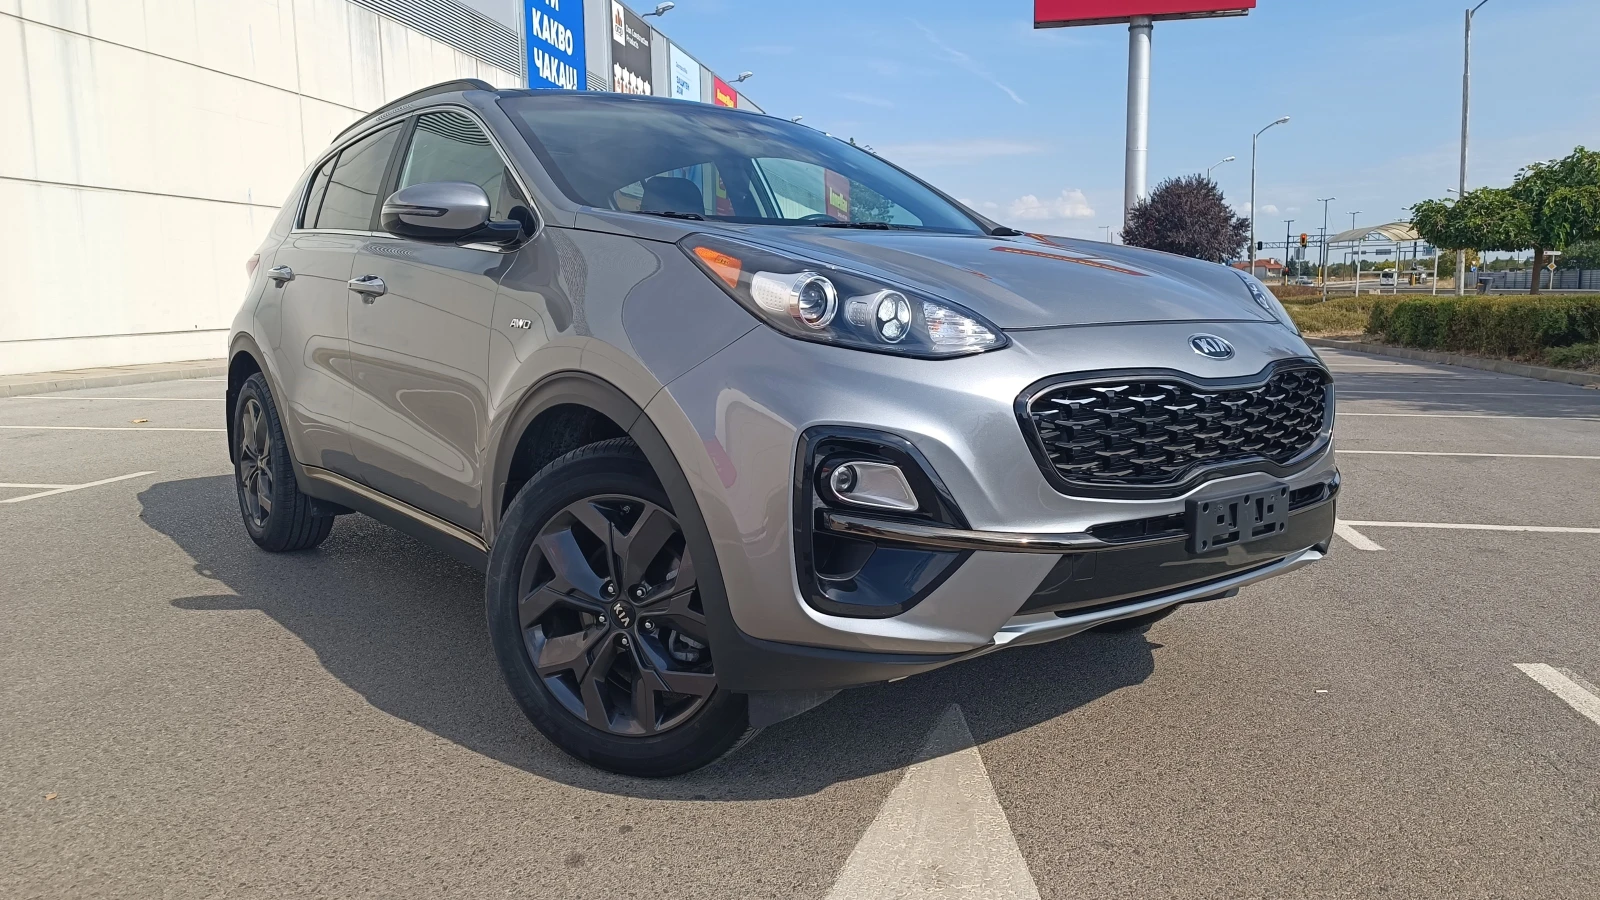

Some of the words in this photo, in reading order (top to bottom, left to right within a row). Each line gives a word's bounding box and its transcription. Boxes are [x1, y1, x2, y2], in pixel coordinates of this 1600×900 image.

[532, 7, 573, 56] КАКВО
[509, 318, 532, 329] AWD
[1194, 338, 1231, 353] KIA
[613, 603, 630, 627] KIA
